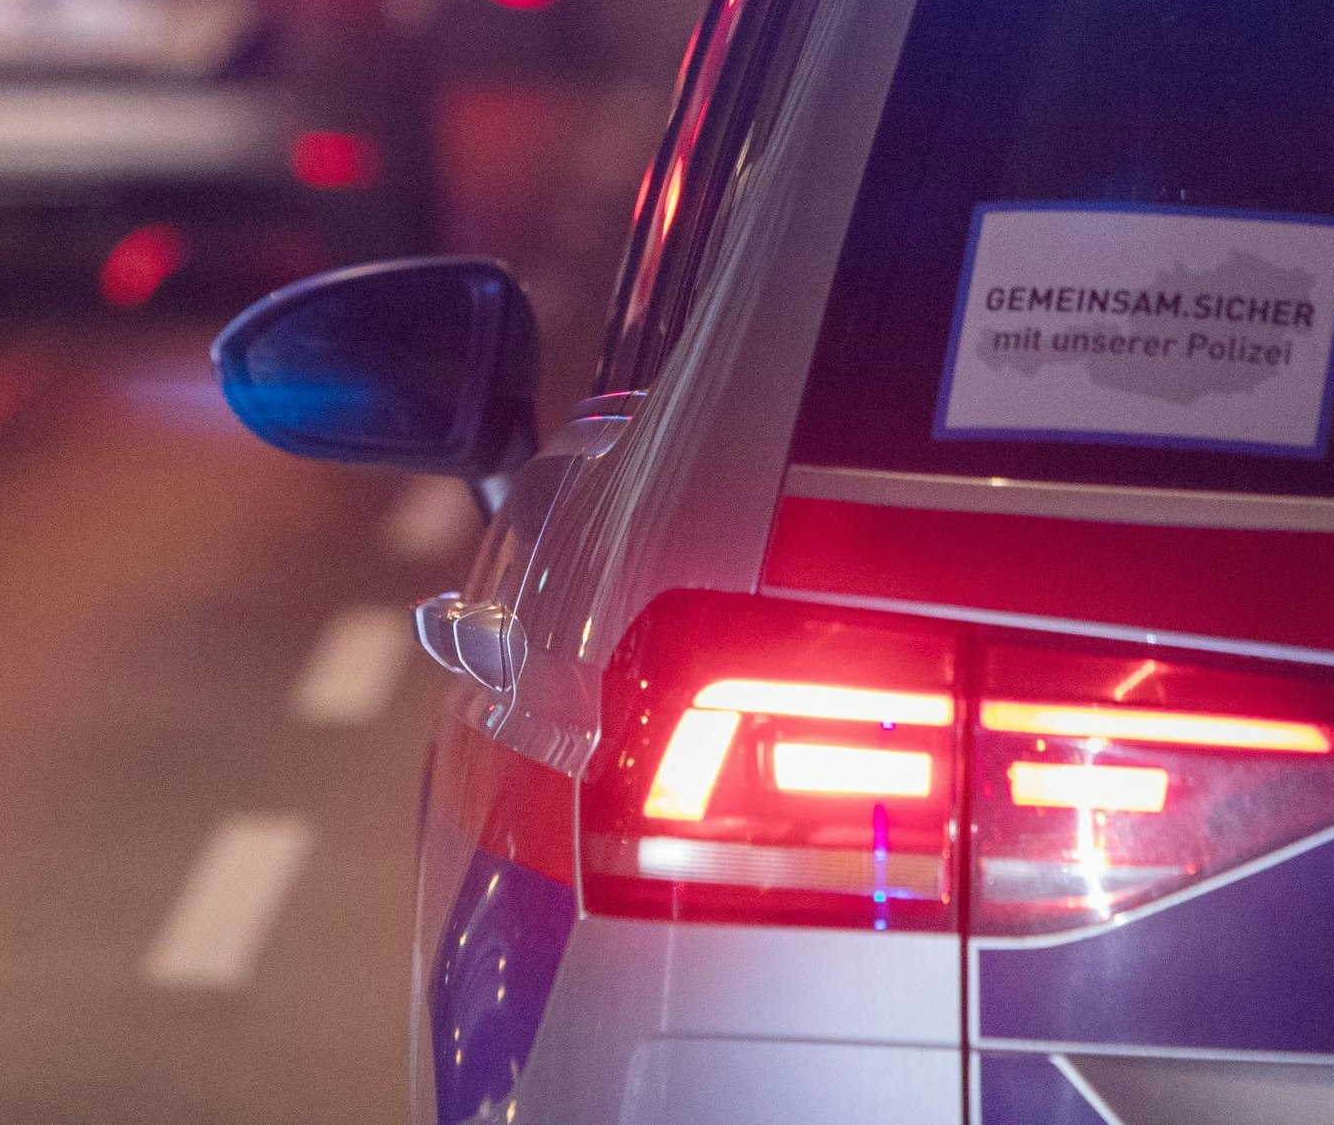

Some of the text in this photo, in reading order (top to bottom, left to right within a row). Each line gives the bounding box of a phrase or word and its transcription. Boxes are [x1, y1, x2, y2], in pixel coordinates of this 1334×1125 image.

[986, 286, 1315, 327] GEMEINSAM.SICHER
[992, 327, 1293, 366] mit unserer Polizei
